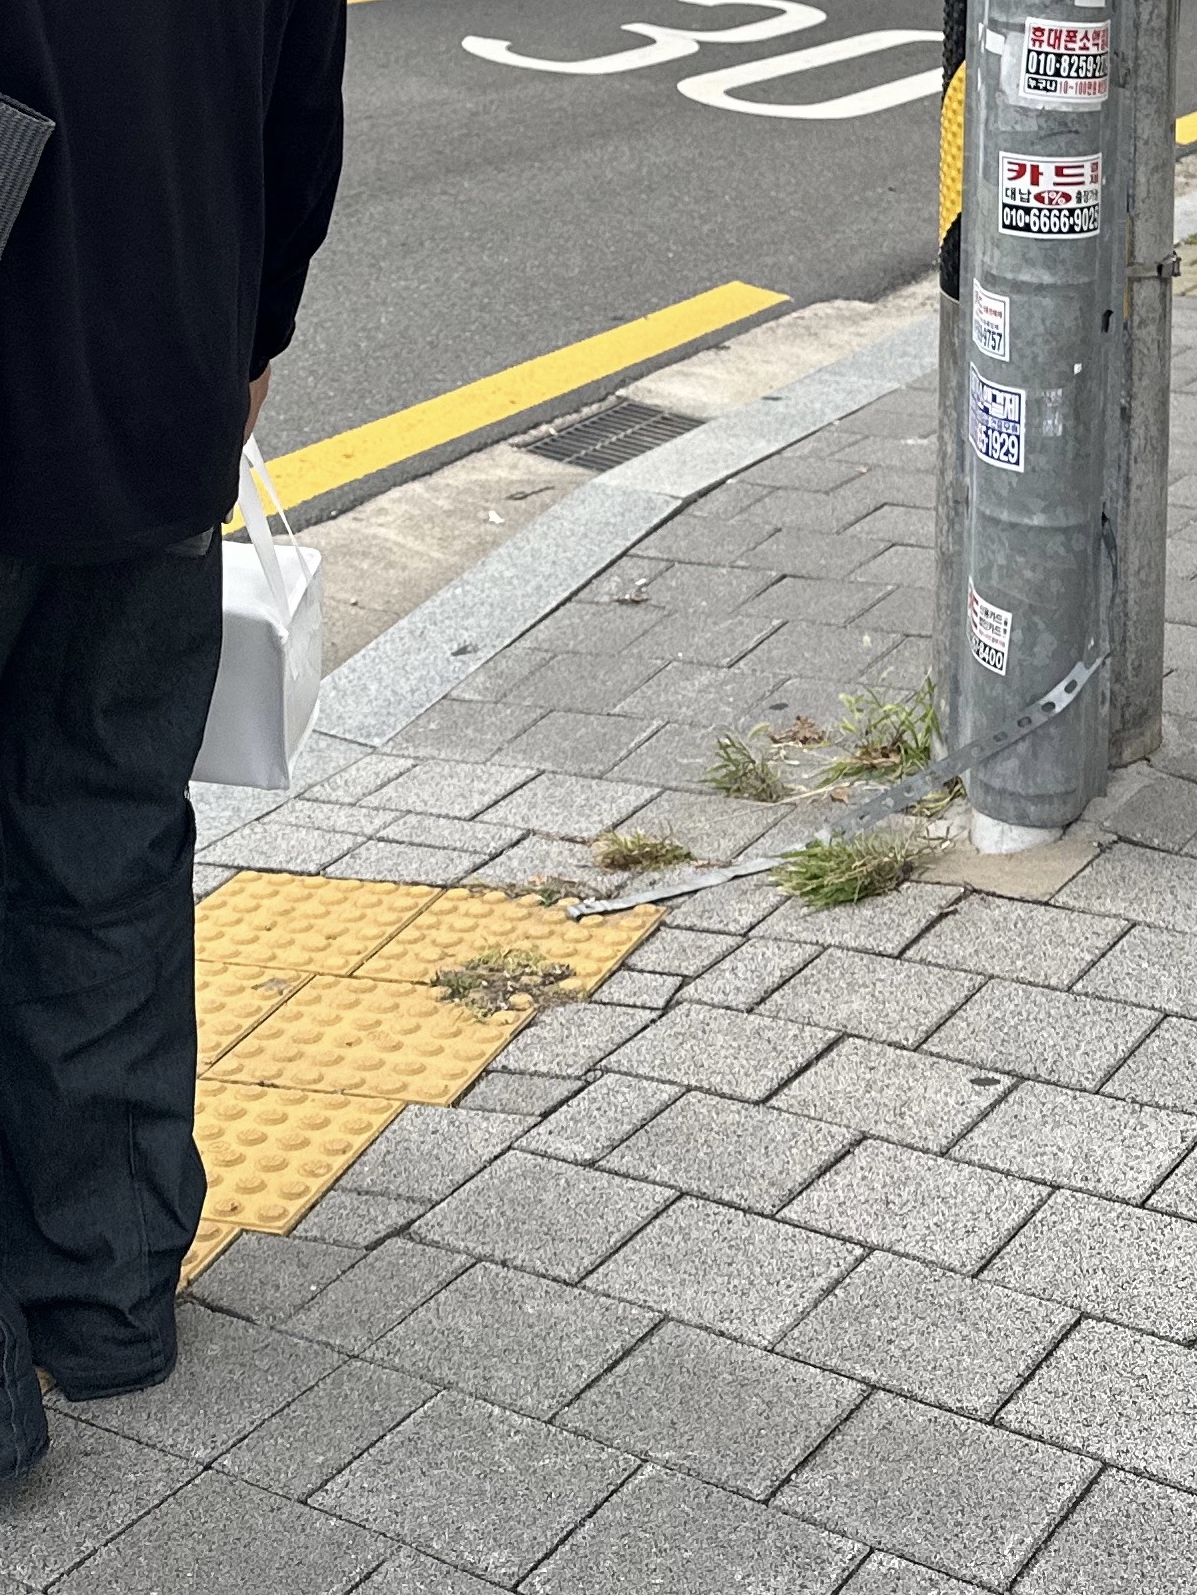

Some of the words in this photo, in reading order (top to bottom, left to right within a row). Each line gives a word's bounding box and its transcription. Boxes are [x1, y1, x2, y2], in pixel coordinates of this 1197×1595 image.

[1007, 161, 1085, 187] 카드
[1005, 187, 1032, 203] 대납
[1041, 191, 1066, 205] 1%
